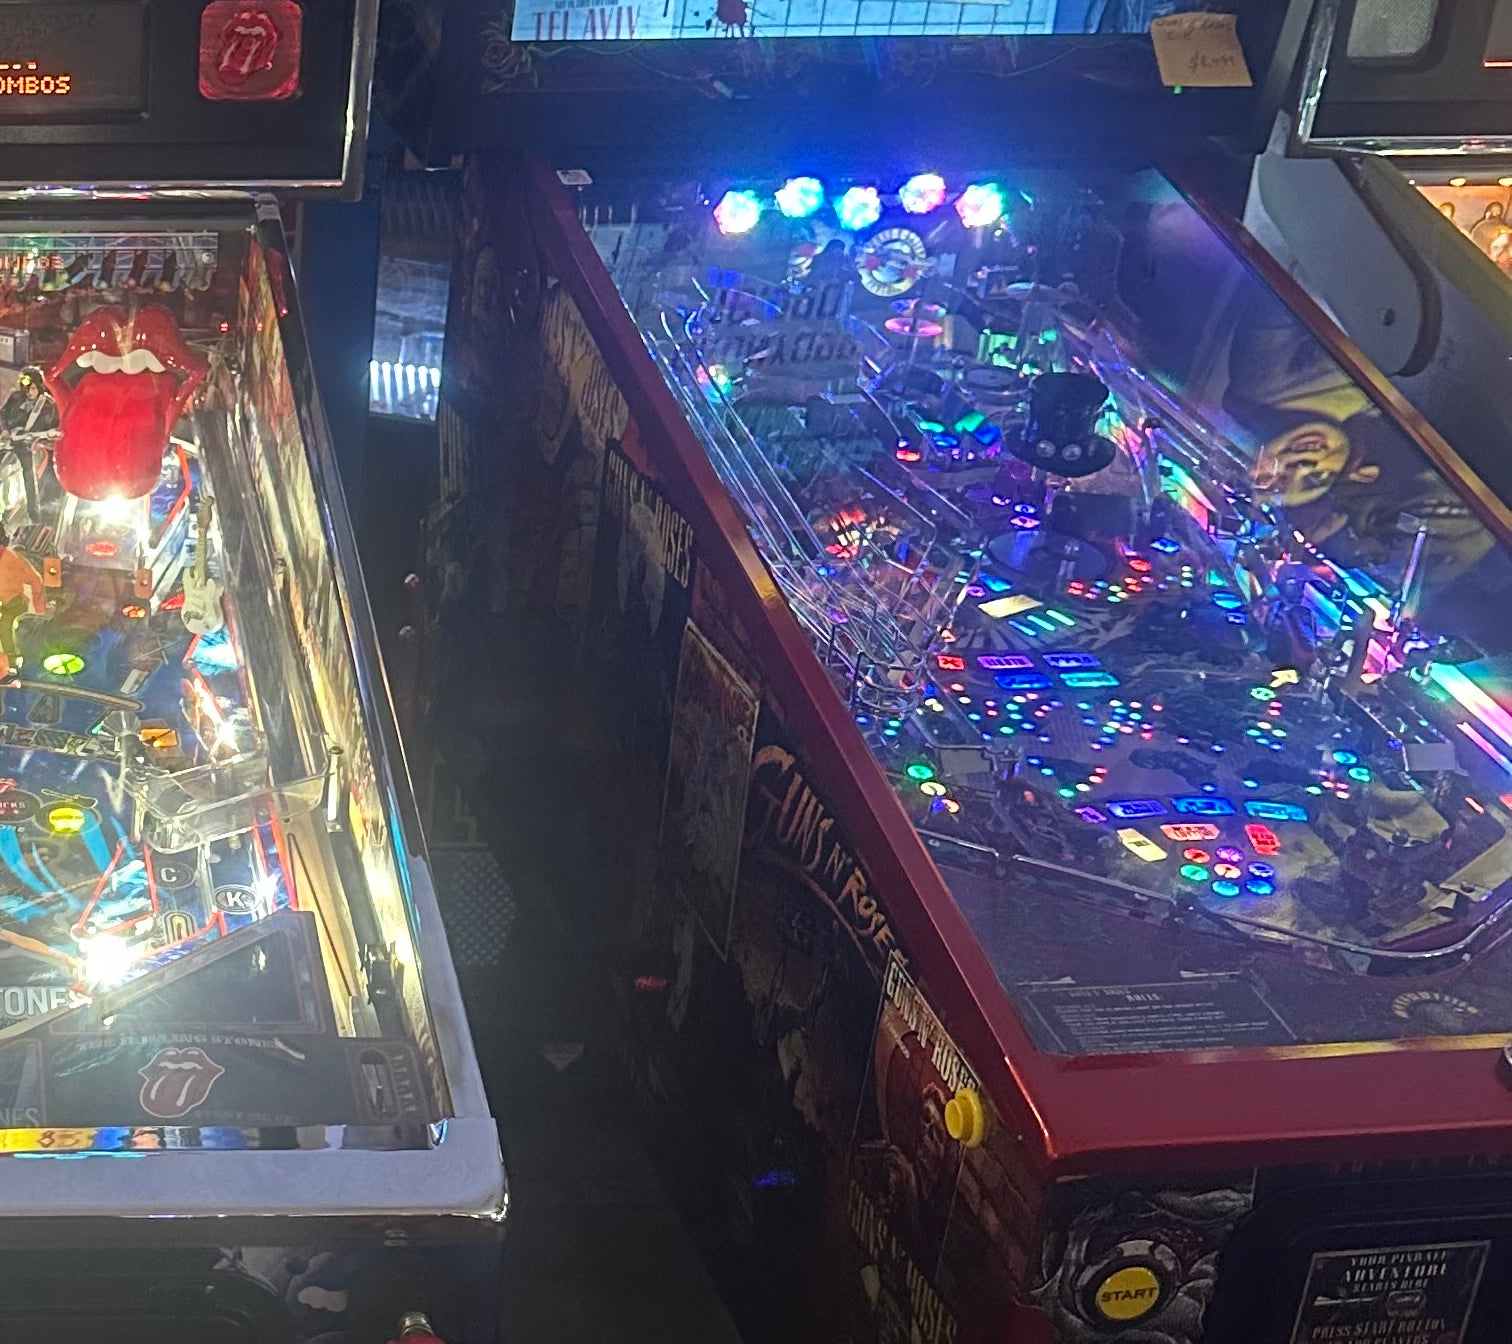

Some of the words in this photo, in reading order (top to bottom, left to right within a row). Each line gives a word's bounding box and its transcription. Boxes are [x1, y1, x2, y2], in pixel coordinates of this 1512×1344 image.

[583, 4, 641, 40] AVIV
[160, 867, 178, 883] C
[226, 891, 245, 908] K
[1101, 1283, 1159, 1304] START
[1312, 1325, 1352, 1339] PRESS
